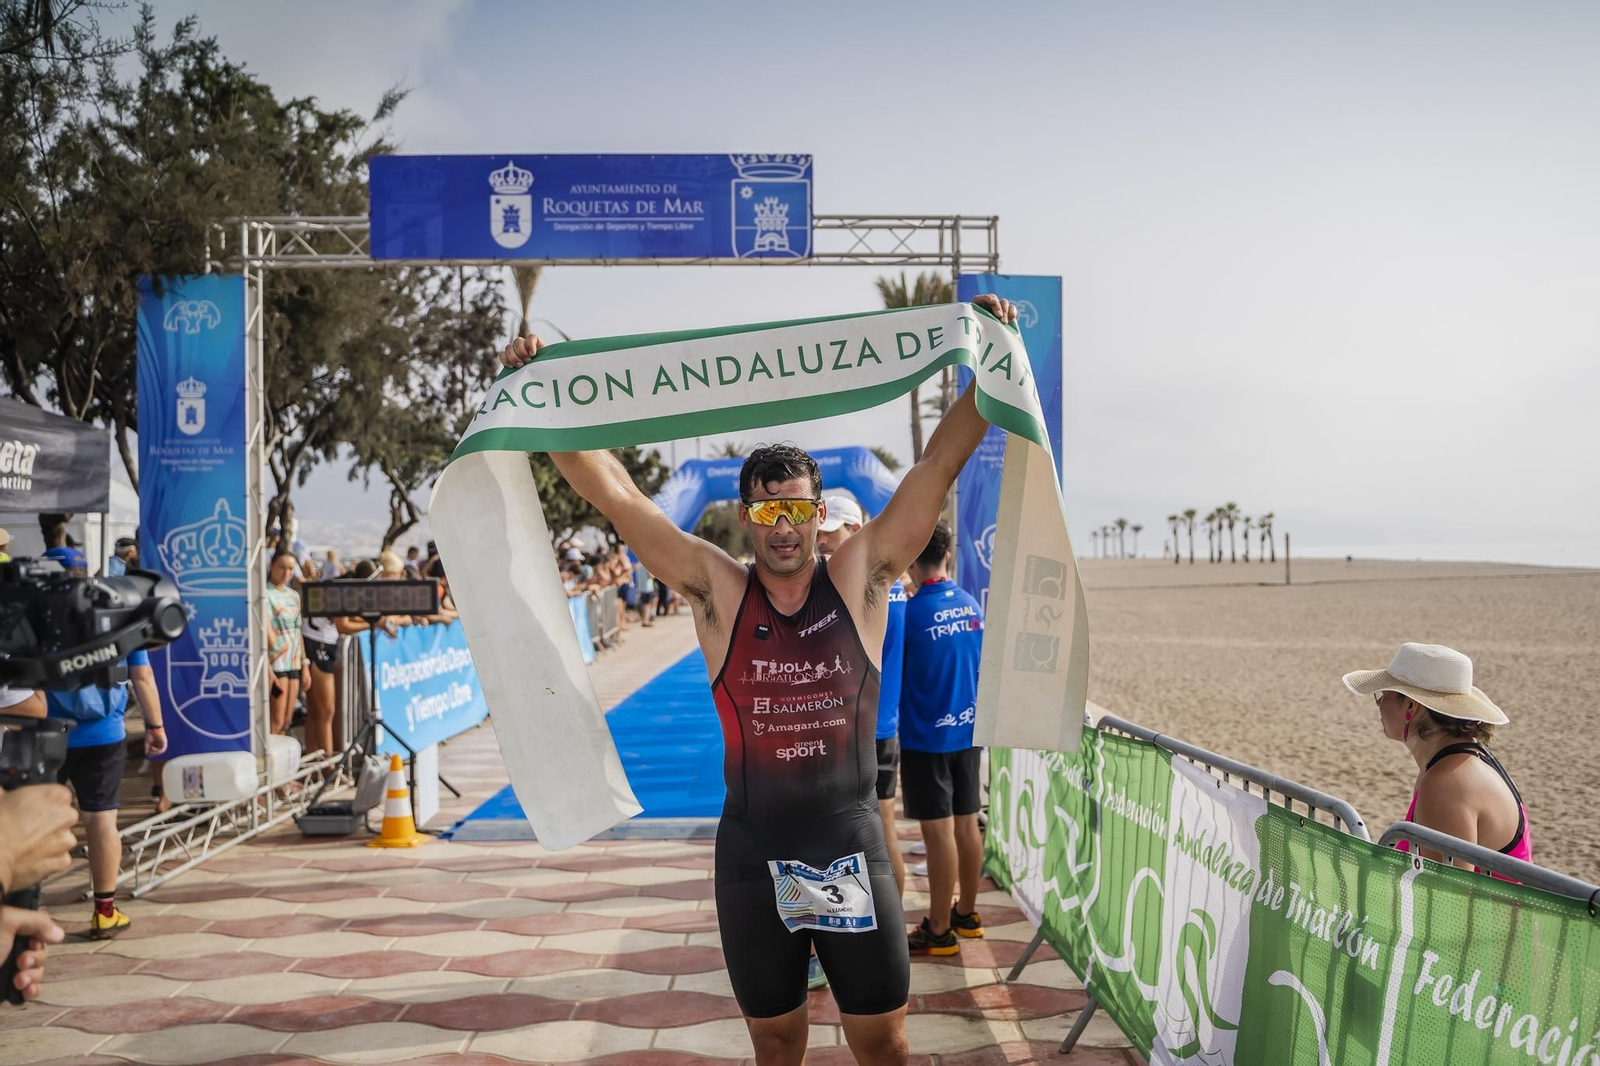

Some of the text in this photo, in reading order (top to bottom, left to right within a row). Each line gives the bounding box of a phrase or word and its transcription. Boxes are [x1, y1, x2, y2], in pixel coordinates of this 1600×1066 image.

[570, 184, 678, 194] AYUNTAMIENTO DE
[543, 197, 629, 217] ROQUETAS
[636, 200, 656, 214] DE
[595, 222, 604, 230] de
[675, 222, 694, 230] Libre
[651, 336, 882, 395] ANDALUZA
[895, 326, 944, 360] DE
[0, 440, 37, 476] eta
[0, 476, 32, 491] ortivo
[798, 609, 838, 638] TREK
[933, 605, 977, 623] OFICIAL
[60, 642, 118, 674] RONIN
[773, 696, 844, 714] SALMERÓN
[781, 691, 834, 702] HORMIGONES
[767, 717, 847, 733] Amagard.com
[776, 739, 827, 762] sport
[794, 740, 819, 749] green
[1103, 781, 1380, 970] Federación Andaluza de Triatlón
[821, 884, 844, 905] 3
